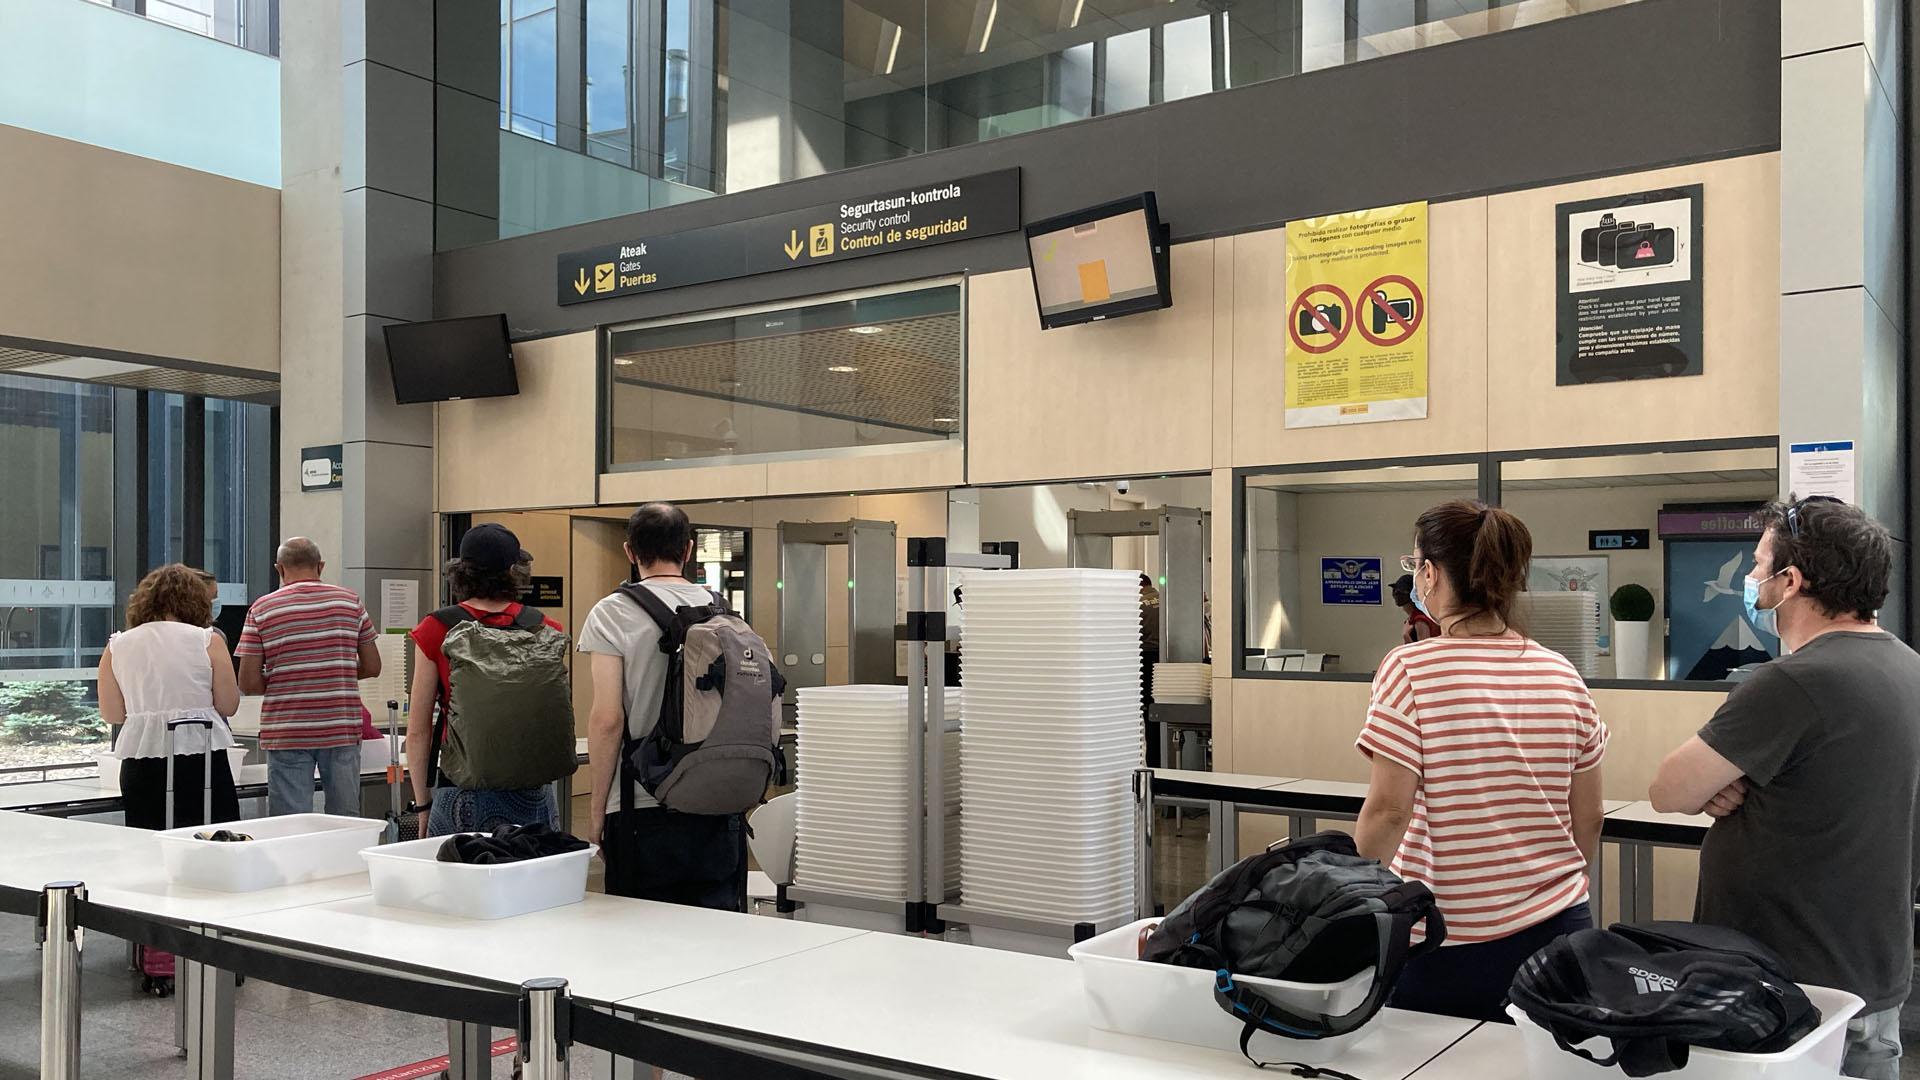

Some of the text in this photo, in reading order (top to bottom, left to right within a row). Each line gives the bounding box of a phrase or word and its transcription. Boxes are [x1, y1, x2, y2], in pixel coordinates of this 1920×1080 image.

[840, 184, 960, 218] Segurtasun-kontrola
[840, 211, 910, 234] Security control
[1394, 216, 1416, 225] grabar
[840, 216, 967, 250] Control de seguridad
[1310, 234, 1340, 243] imágenes
[620, 243, 647, 259] Ateak
[620, 261, 641, 273] Gates
[620, 272, 657, 288] Puertas
